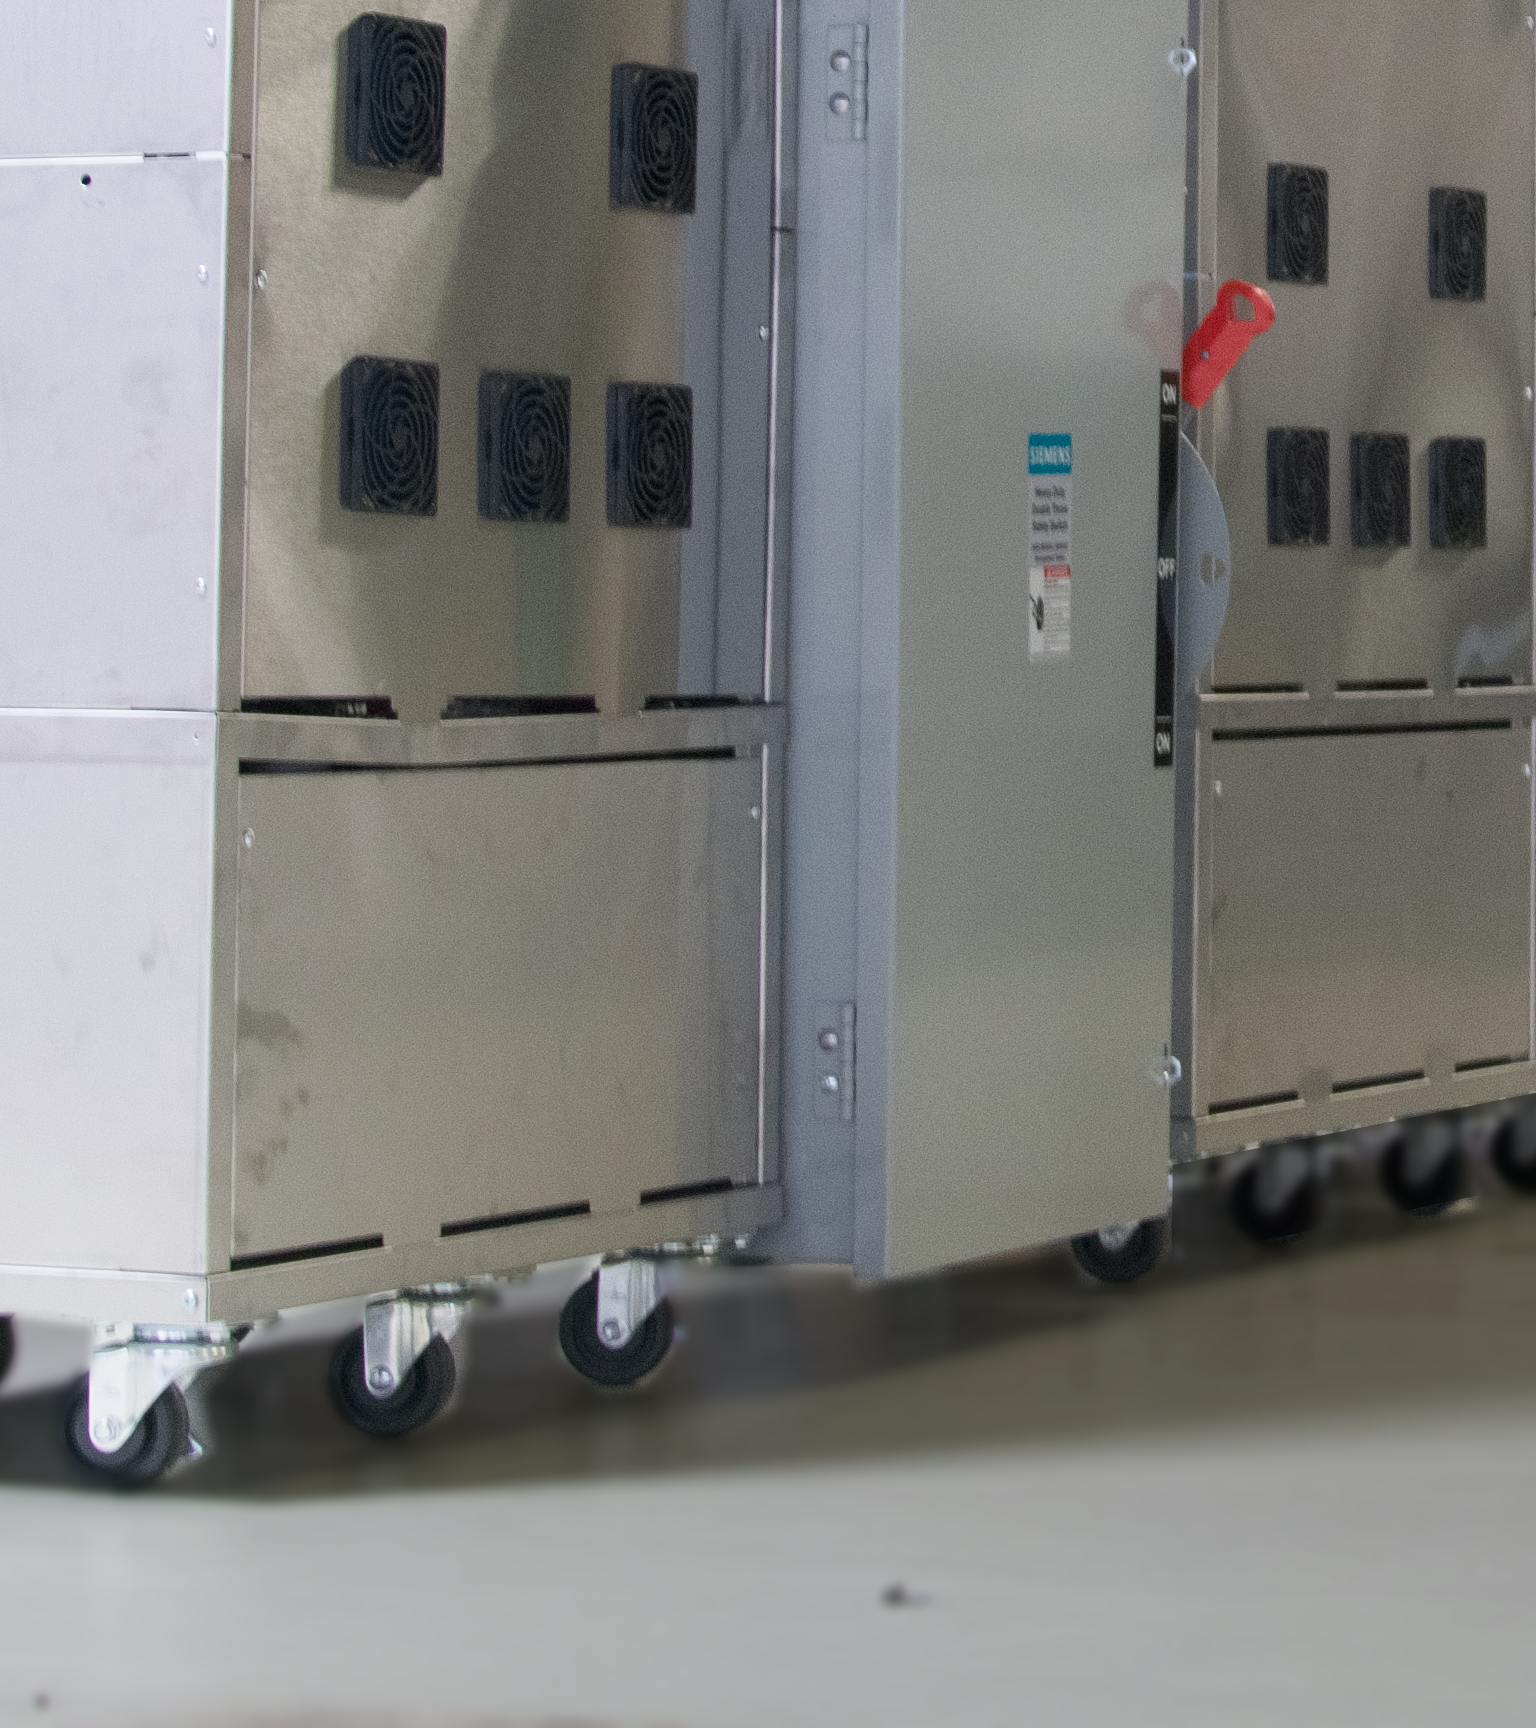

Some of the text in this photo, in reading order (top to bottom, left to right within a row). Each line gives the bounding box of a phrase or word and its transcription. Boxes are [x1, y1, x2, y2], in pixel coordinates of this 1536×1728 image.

[1162, 382, 1177, 405] ON
[1029, 445, 1070, 465] SIEMENS
[1158, 558, 1176, 580] OFF
[1156, 732, 1171, 754] ON
